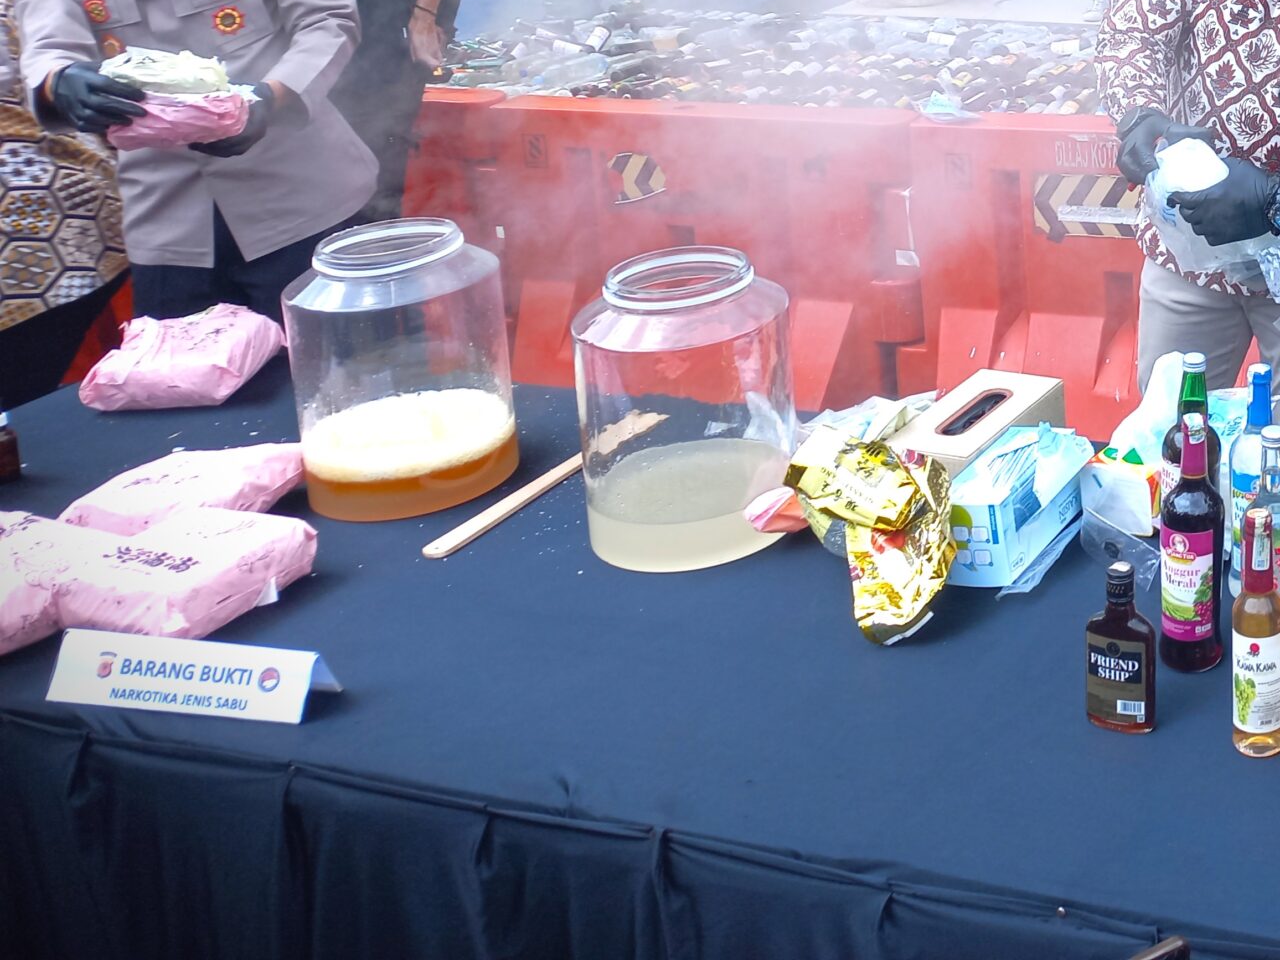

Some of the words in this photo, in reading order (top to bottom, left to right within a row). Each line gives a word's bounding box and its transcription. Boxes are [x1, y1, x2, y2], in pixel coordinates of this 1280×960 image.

[120, 658, 196, 681] BARANG
[199, 665, 253, 686] BUKTI
[1090, 652, 1140, 672] FRIEND
[1236, 658, 1256, 673] KAWA
[1256, 662, 1278, 674] KAWA
[1097, 667, 1130, 683] SHIP
[109, 687, 177, 705] NARKOTIKA
[180, 693, 213, 708] JENIS
[215, 696, 249, 711] SABU
